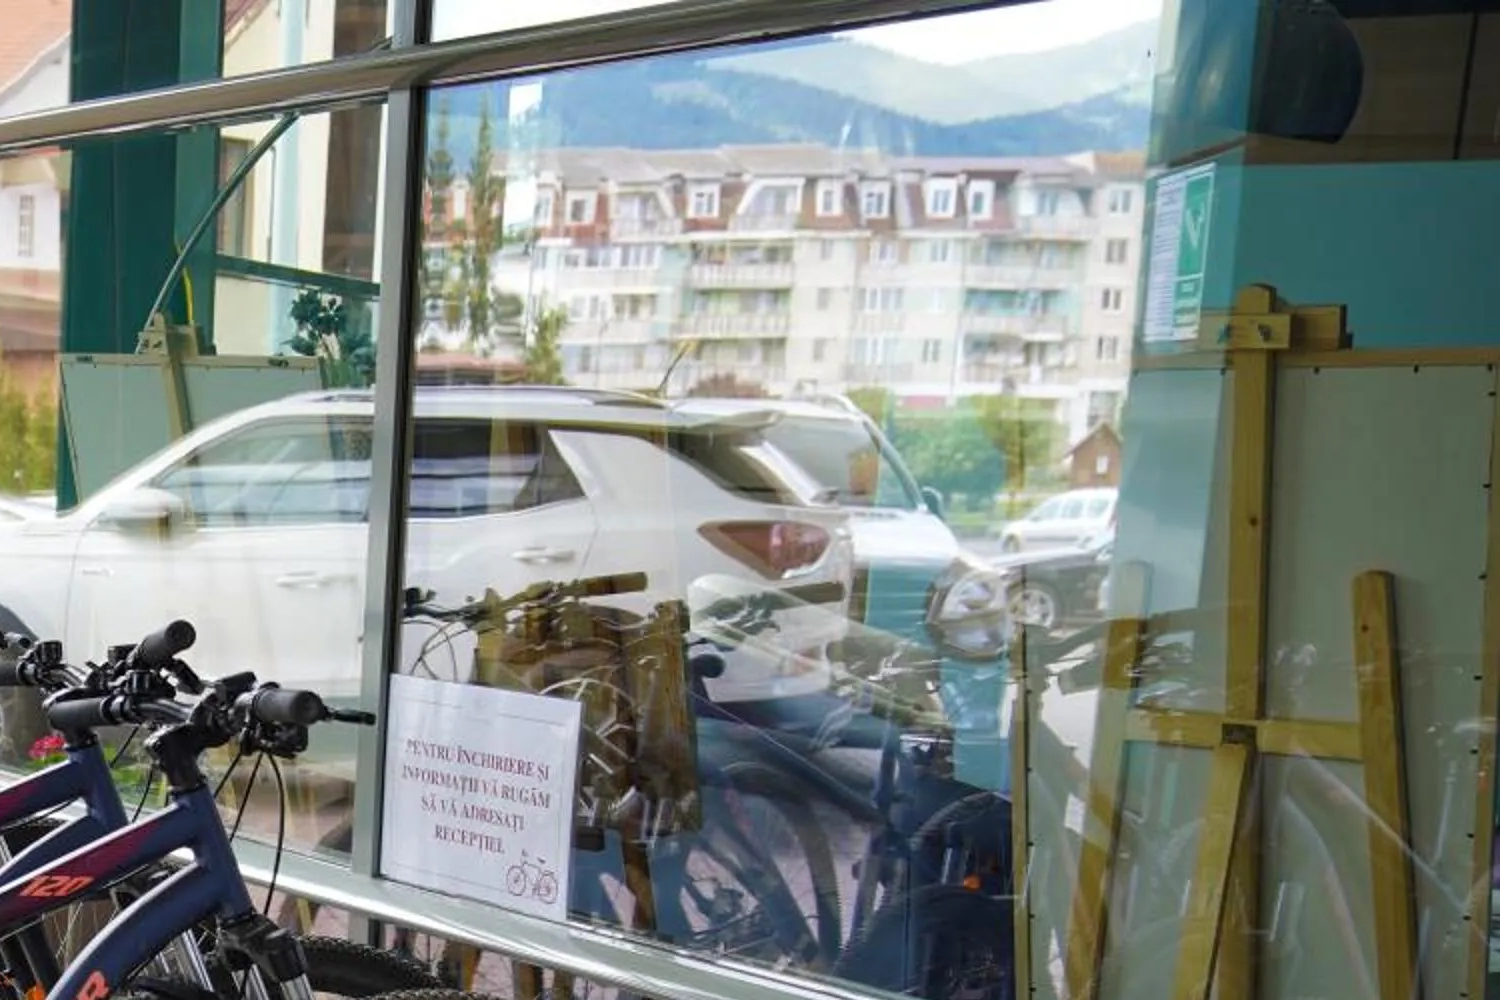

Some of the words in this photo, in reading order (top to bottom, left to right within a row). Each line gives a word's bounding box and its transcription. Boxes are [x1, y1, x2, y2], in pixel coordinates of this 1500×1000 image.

[406, 738, 456, 762] PENTRU
[457, 744, 535, 777] ÎNCHIRIERE
[501, 784, 551, 808] RUGĂM
[18, 875, 95, 897] 120
